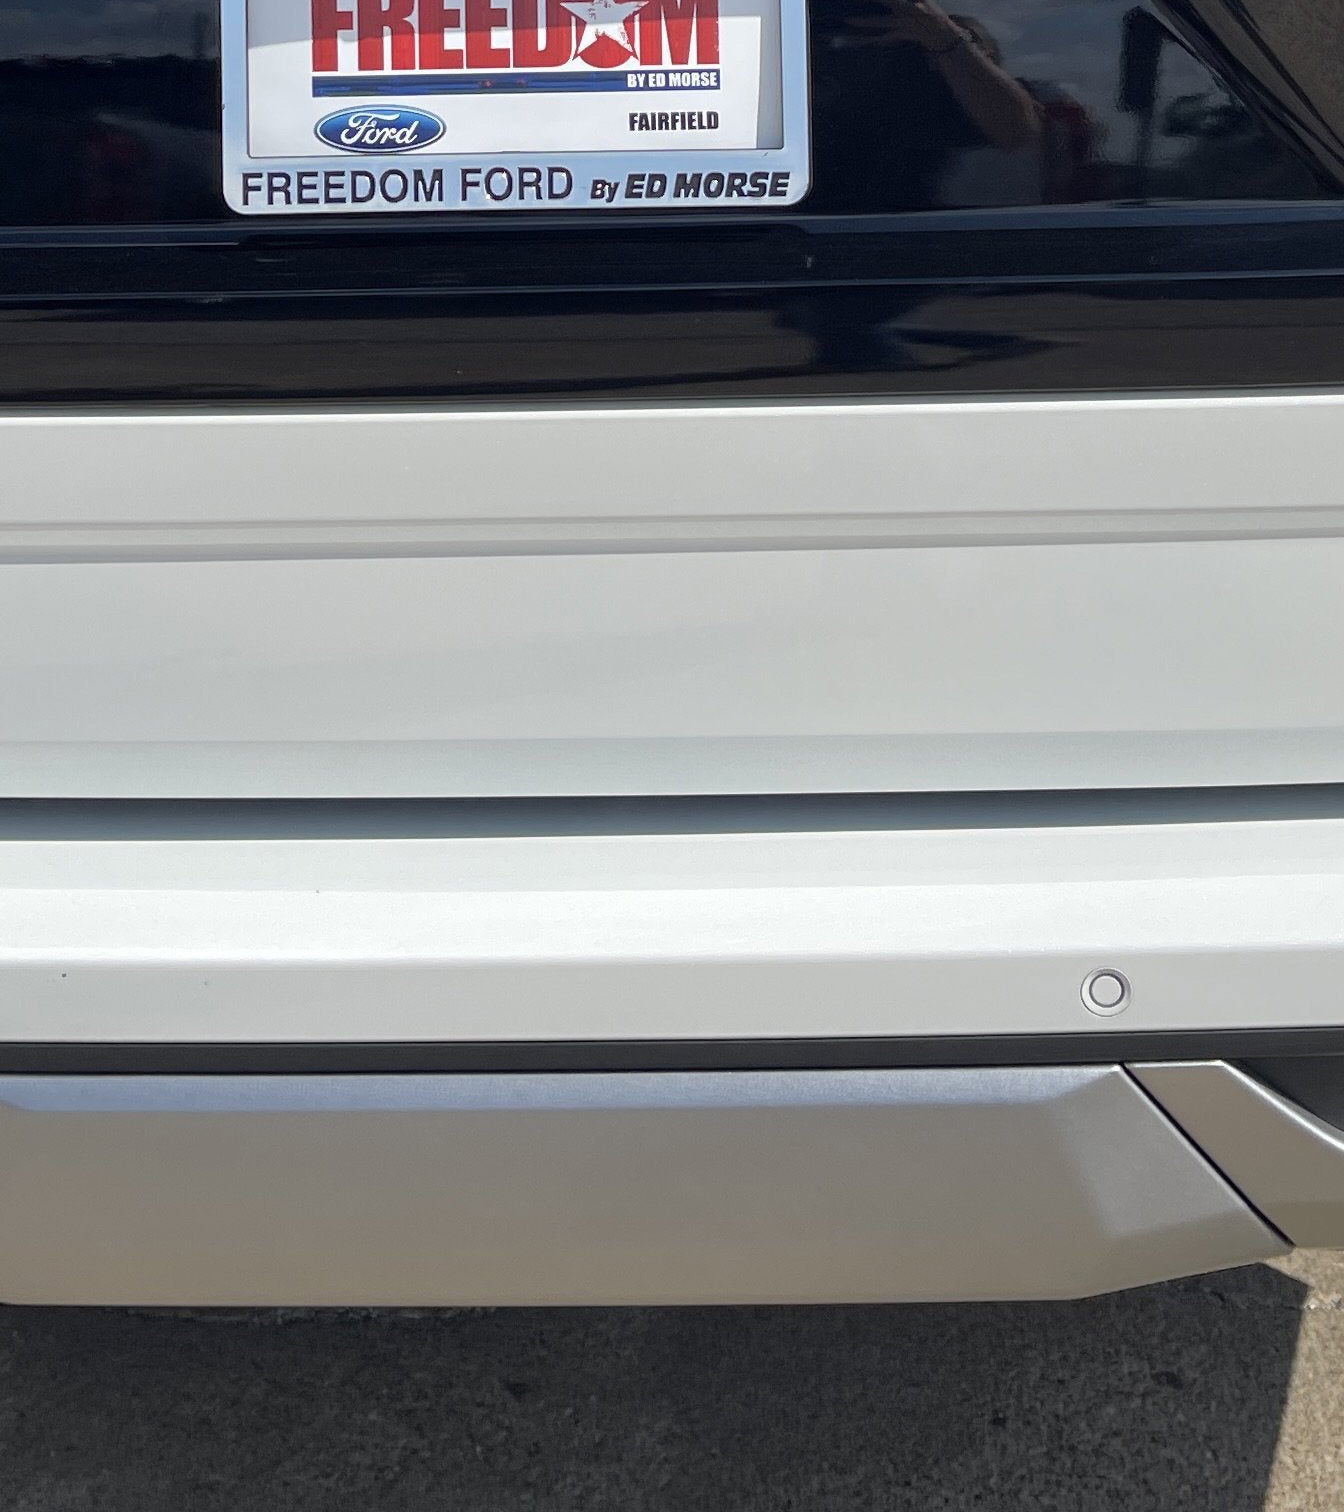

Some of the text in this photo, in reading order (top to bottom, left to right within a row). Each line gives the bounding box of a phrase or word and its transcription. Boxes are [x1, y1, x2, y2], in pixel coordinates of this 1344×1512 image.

[627, 71, 718, 88] BY ED MORSE
[340, 112, 419, 146] Ford
[629, 111, 720, 131] FAIRFIELD
[241, 166, 791, 206] FREEDOM FORD By ED MORSE
